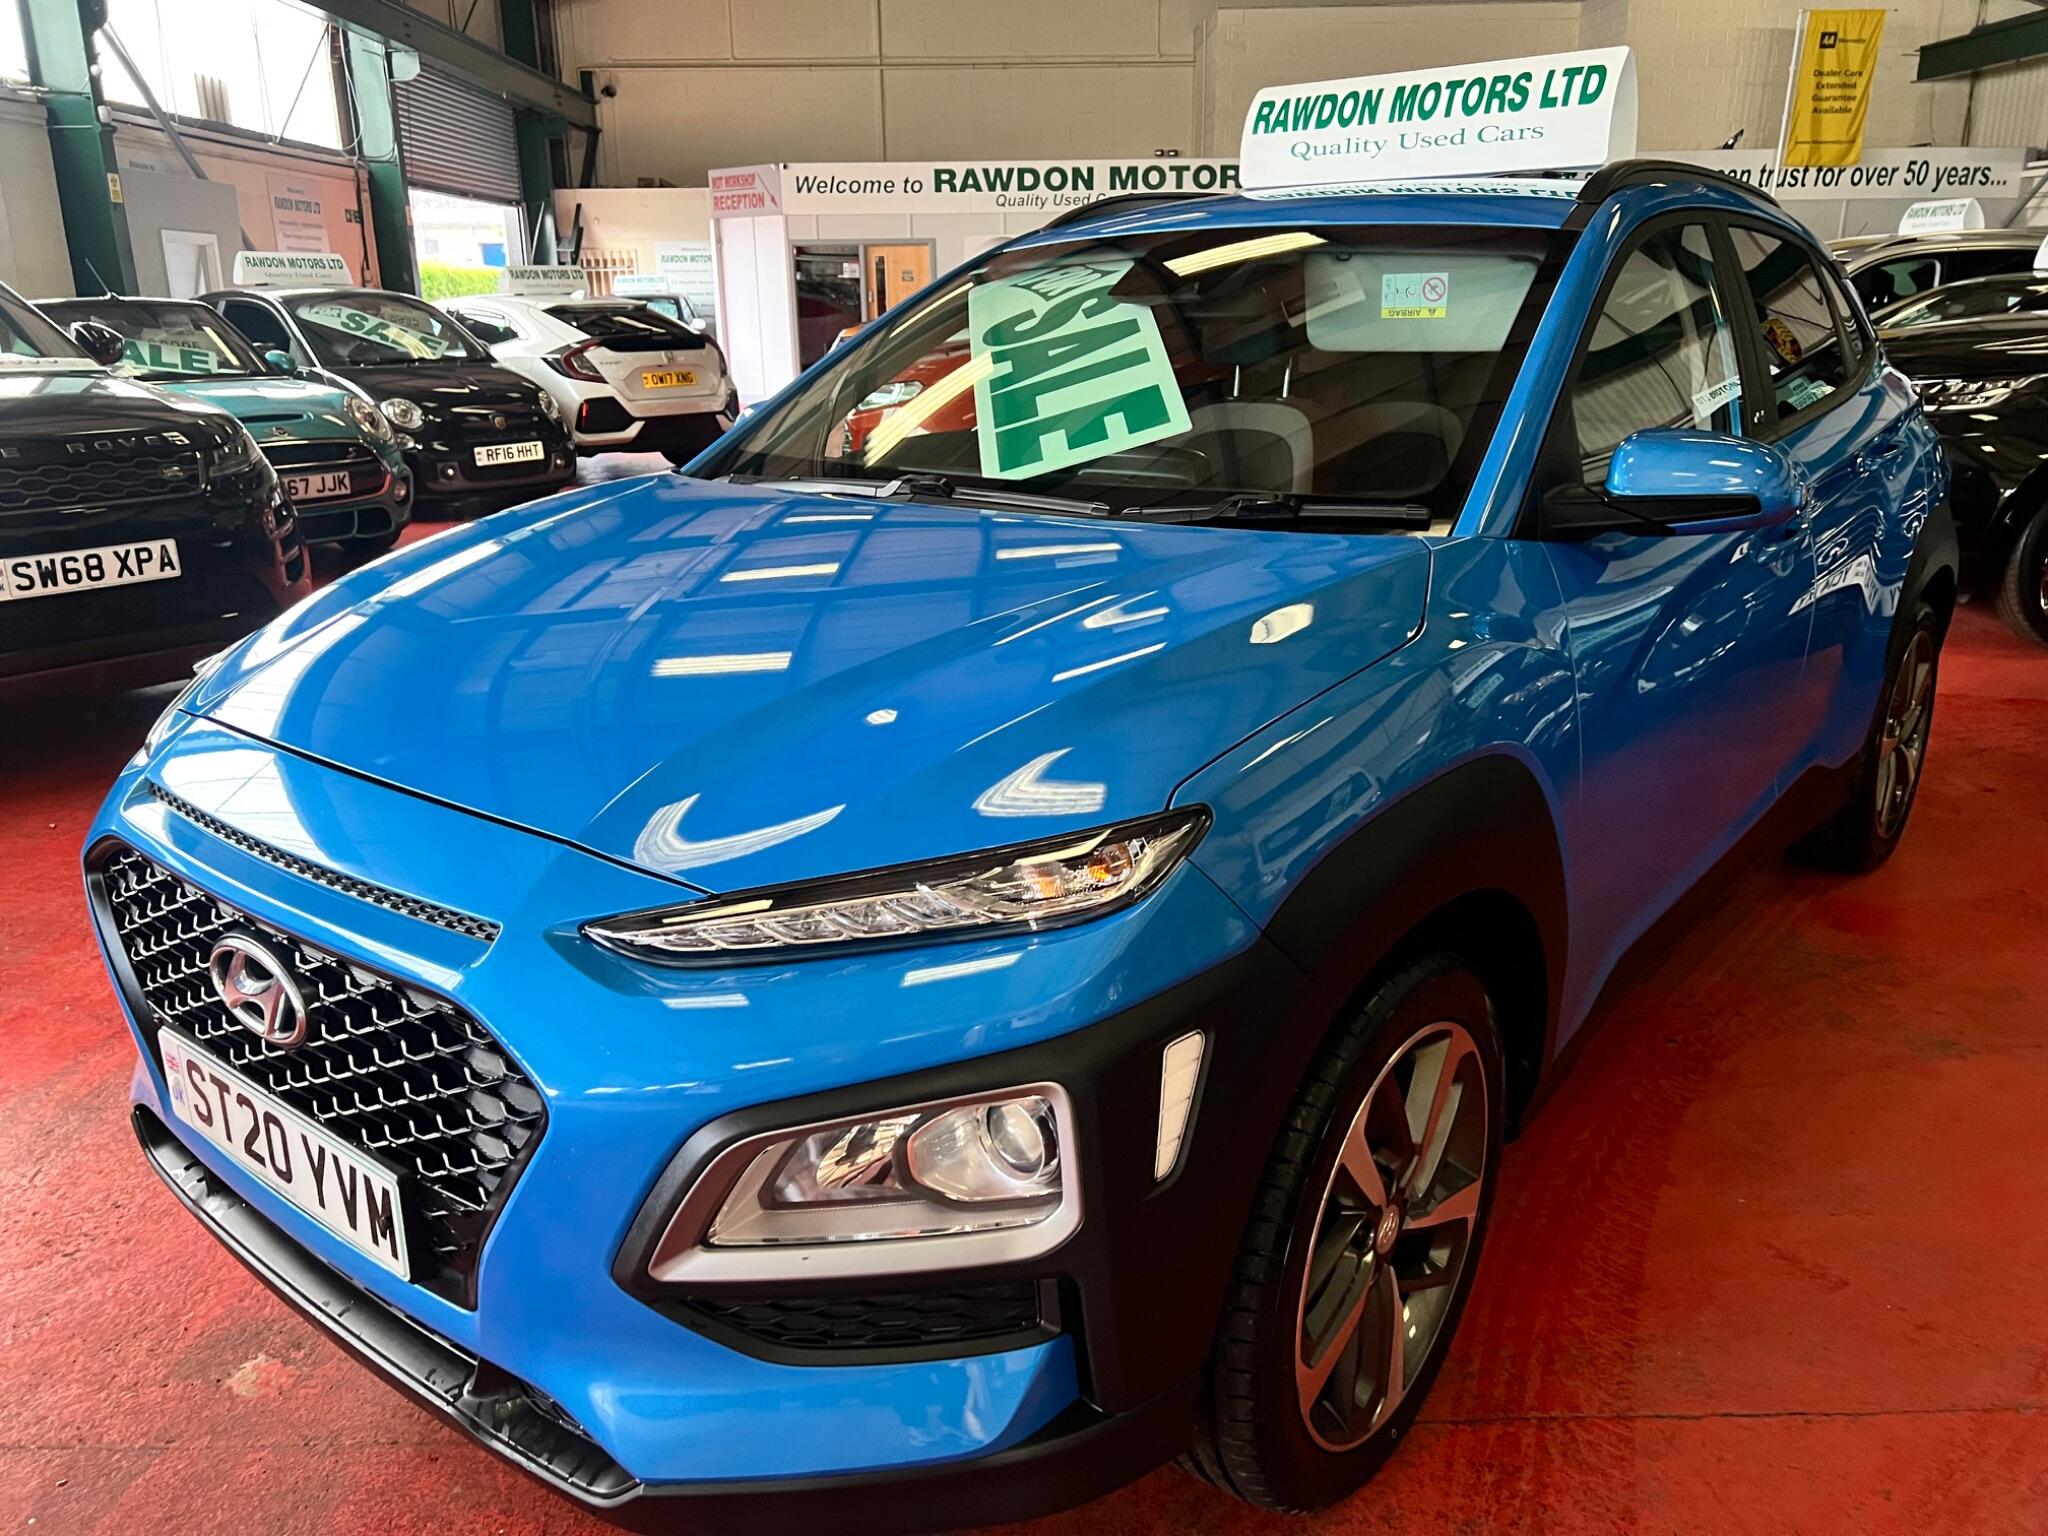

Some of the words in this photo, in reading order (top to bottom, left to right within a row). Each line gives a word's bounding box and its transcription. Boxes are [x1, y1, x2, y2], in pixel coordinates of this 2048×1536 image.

[1813, 69, 1841, 77] Dealer
[1844, 69, 1864, 77] Care
[1815, 80, 1857, 90] Extended
[1252, 88, 1384, 136] RAWDON
[1388, 72, 1532, 123] MOTORS
[1539, 64, 1608, 109] LTD
[1811, 93, 1857, 103] Guarantee
[1812, 106, 1853, 114] Available
[1291, 136, 1388, 162] Quality
[1399, 126, 1466, 151] Used
[1477, 123, 1544, 143] Cars
[795, 176, 895, 194] Welcome
[903, 178, 923, 194] to
[934, 167, 1094, 192] RAWDON
[1109, 165, 1239, 190] MOTOR
[1758, 164, 1809, 188] trust
[1813, 165, 1845, 187] for
[1850, 165, 1898, 187] over
[1903, 159, 1930, 187] 50
[1934, 162, 2007, 193] years...
[713, 192, 765, 210] RECEPTION
[996, 194, 1046, 208] Quality
[1053, 193, 1091, 206] Used
[245, 256, 286, 268] RAWDON
[287, 257, 326, 270] MOTORS
[328, 259, 344, 270] LTD
[690, 254, 713, 263] MOTOR
[541, 269, 571, 280] MOTORS
[571, 270, 584, 280] LTD
[1388, 308, 1421, 316] AIRBAG
[124, 341, 212, 375] ALE
[982, 284, 1171, 473] SALE
[486, 447, 514, 461] RF16
[517, 444, 542, 458] HHT
[284, 478, 310, 496] 67
[316, 474, 349, 493] JJK
[11, 554, 105, 591] SW68
[113, 544, 176, 578] XPA
[186, 1059, 293, 1184] ST20
[301, 1132, 399, 1261] YVM
